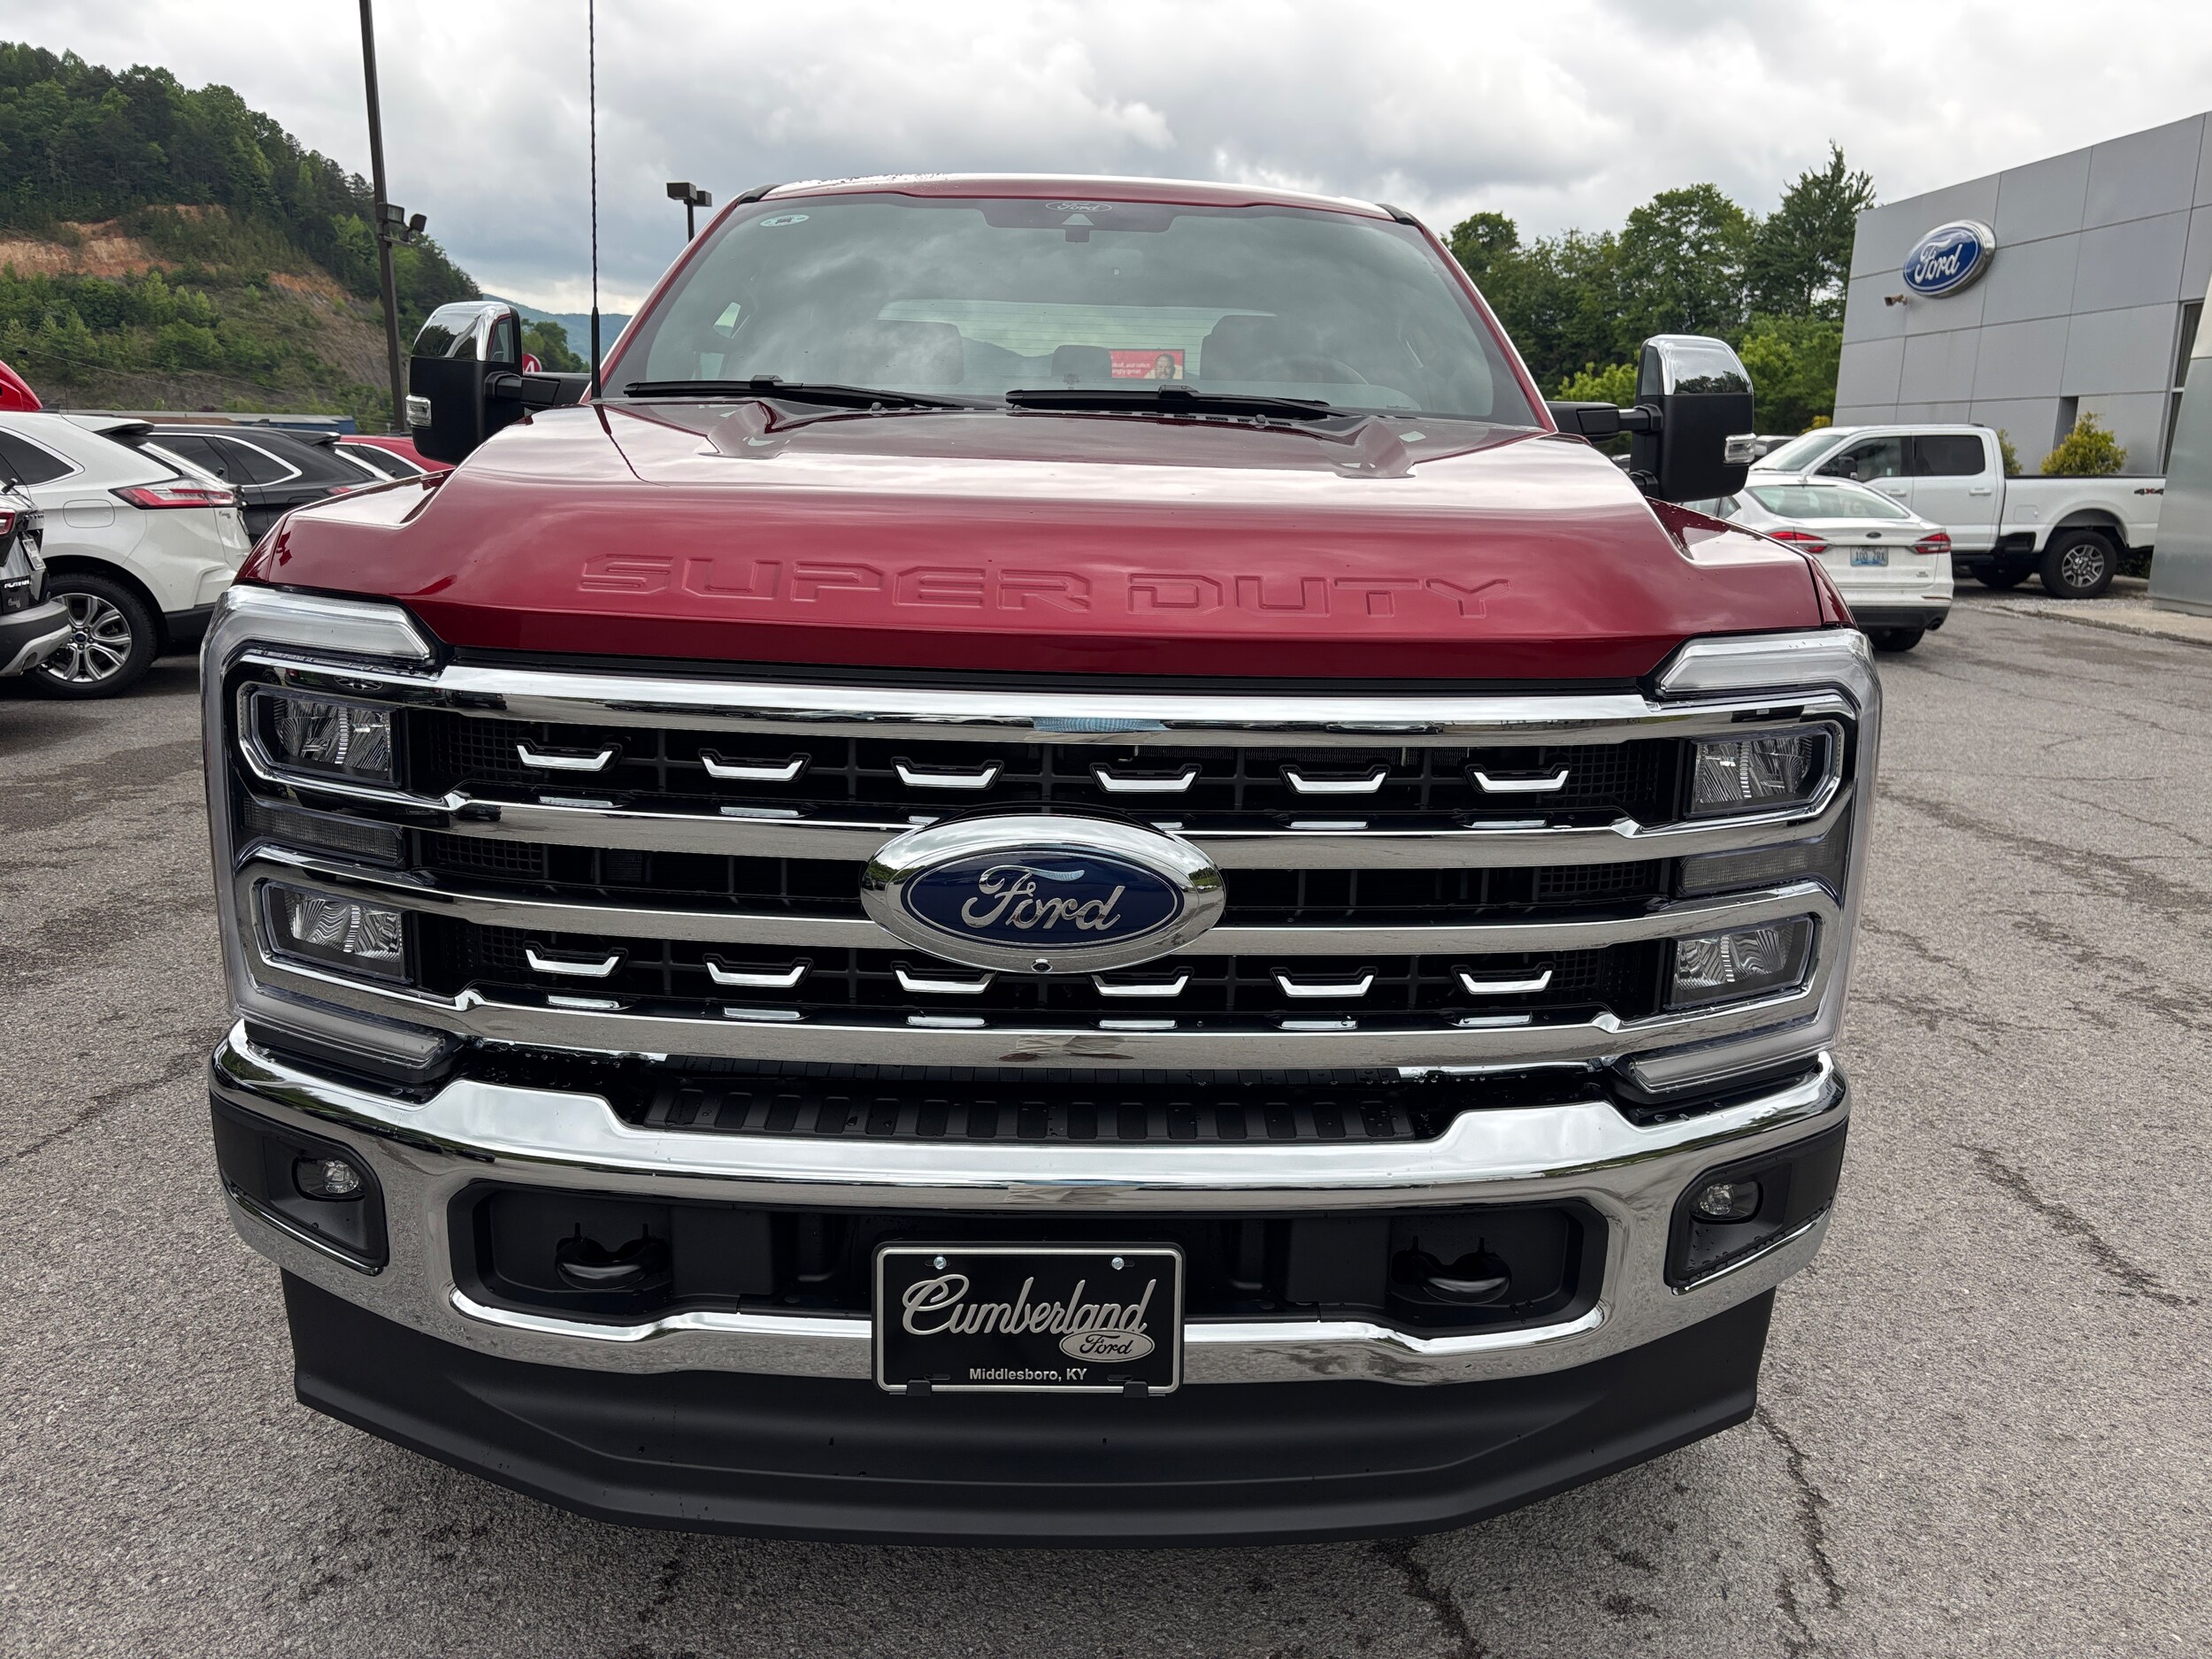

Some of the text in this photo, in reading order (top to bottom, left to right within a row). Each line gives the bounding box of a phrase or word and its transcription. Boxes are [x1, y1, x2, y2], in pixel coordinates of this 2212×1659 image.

[1914, 238, 1963, 284] Ford
[577, 553, 1511, 618] SUPER DUTY
[961, 864, 1122, 931] Ford
[902, 1274, 1156, 1335] Cumberland
[1079, 1333, 1134, 1356] Ford
[969, 1368, 1087, 1382] Middlesboro, KY
